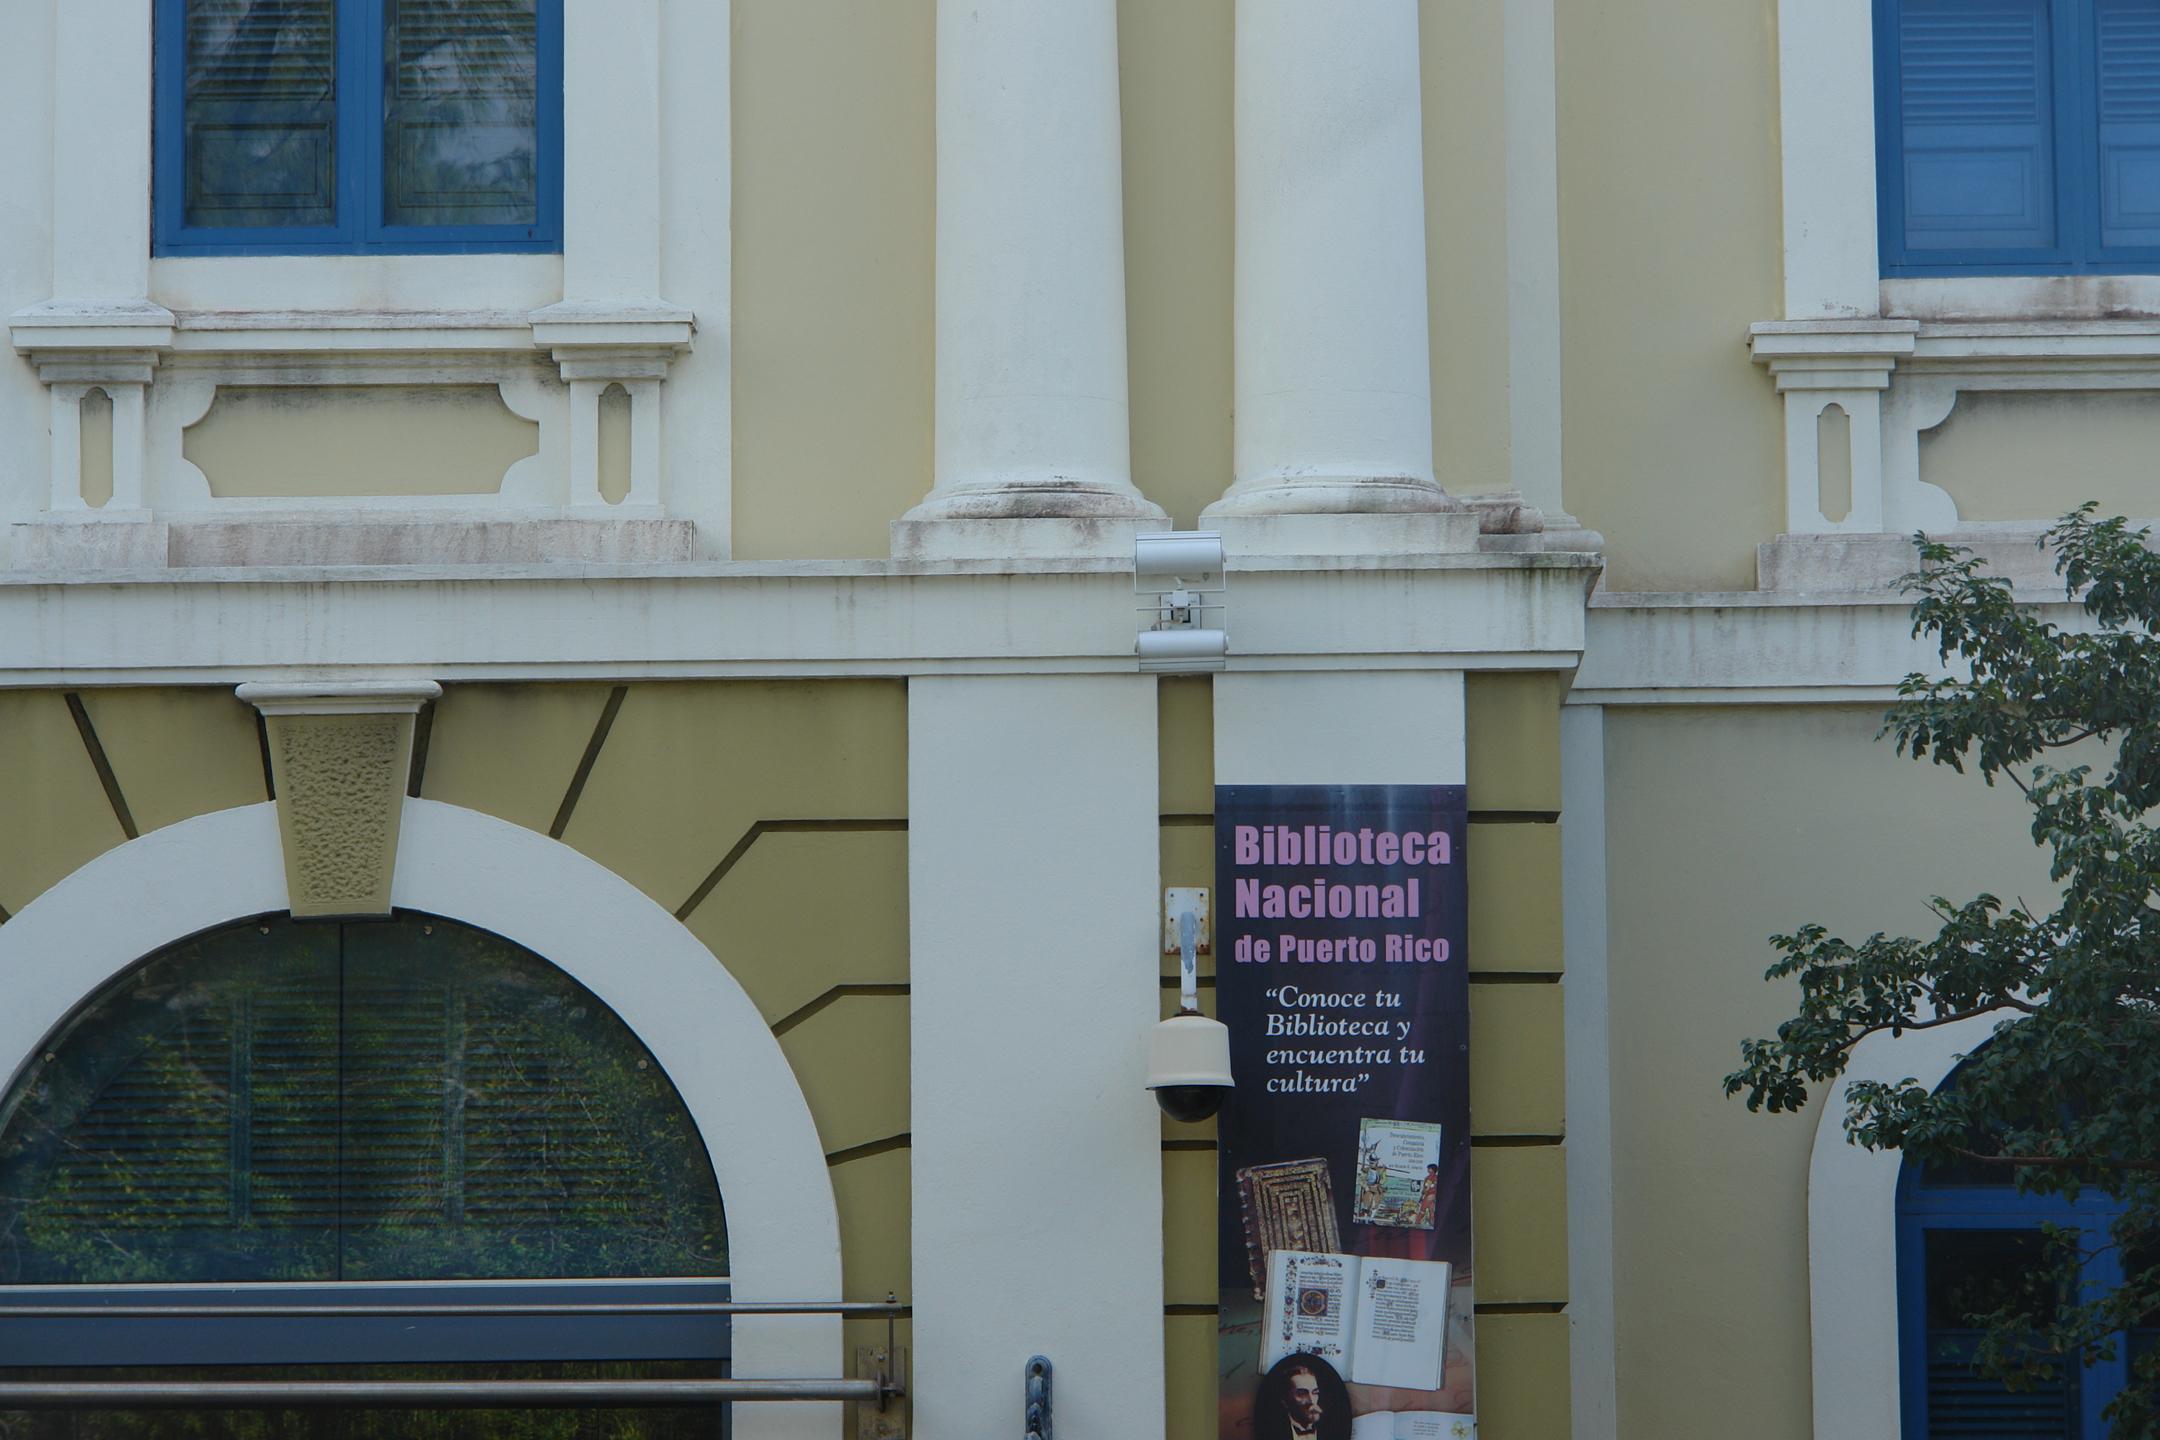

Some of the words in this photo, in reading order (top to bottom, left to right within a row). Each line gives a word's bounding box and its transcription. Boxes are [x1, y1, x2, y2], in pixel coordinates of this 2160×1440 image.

[1235, 825, 1451, 866] Biblioteca
[1235, 878, 1420, 919] Nacional
[1235, 934, 1271, 963] de
[1279, 934, 1377, 963] Puerto
[1385, 934, 1450, 962] Rico
[1265, 985, 1366, 1008] “Conoce
[1375, 990, 1401, 1008] tu
[1265, 1013, 1390, 1036] Biblioteca
[1396, 1021, 1411, 1041] y
[1266, 1046, 1392, 1064] encuentra
[1399, 1046, 1425, 1064] tu
[1266, 1070, 1370, 1093] cultura”
